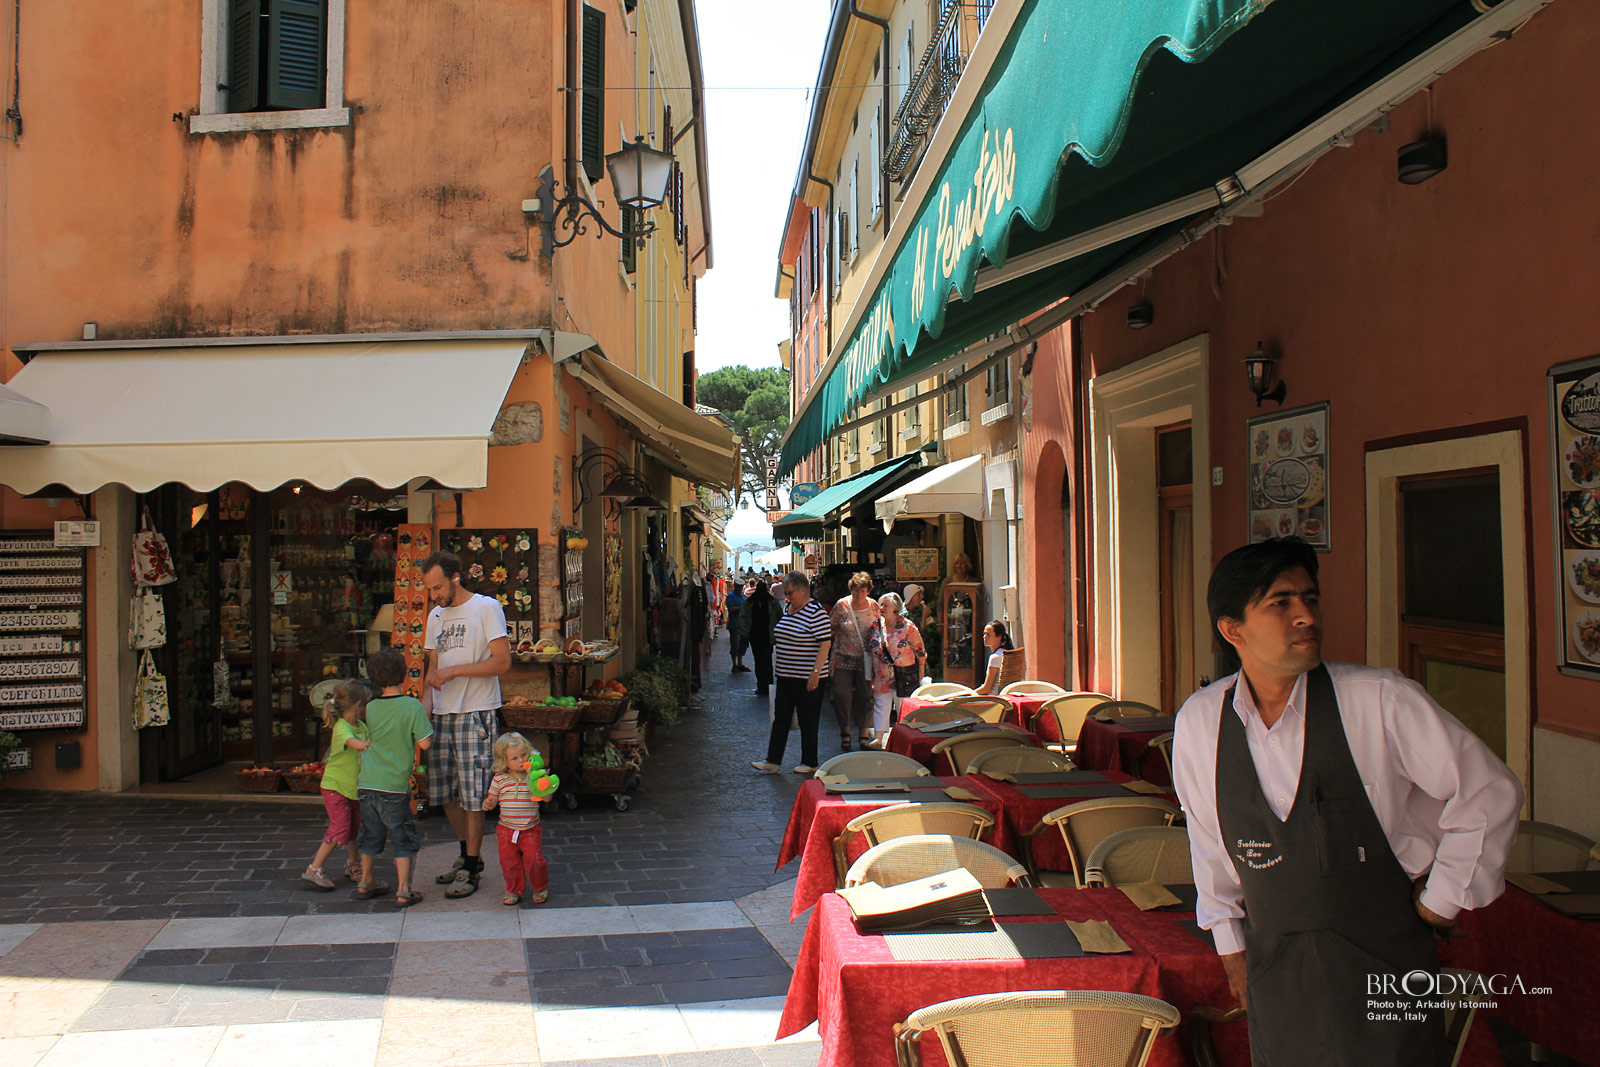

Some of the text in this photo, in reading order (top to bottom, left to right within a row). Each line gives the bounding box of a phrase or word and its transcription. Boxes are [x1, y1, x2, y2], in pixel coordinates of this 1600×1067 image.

[911, 224, 928, 324] Al
[933, 127, 1016, 291] Pescatore
[767, 459, 777, 506] GARNI
[9, 753, 24, 765] 27
